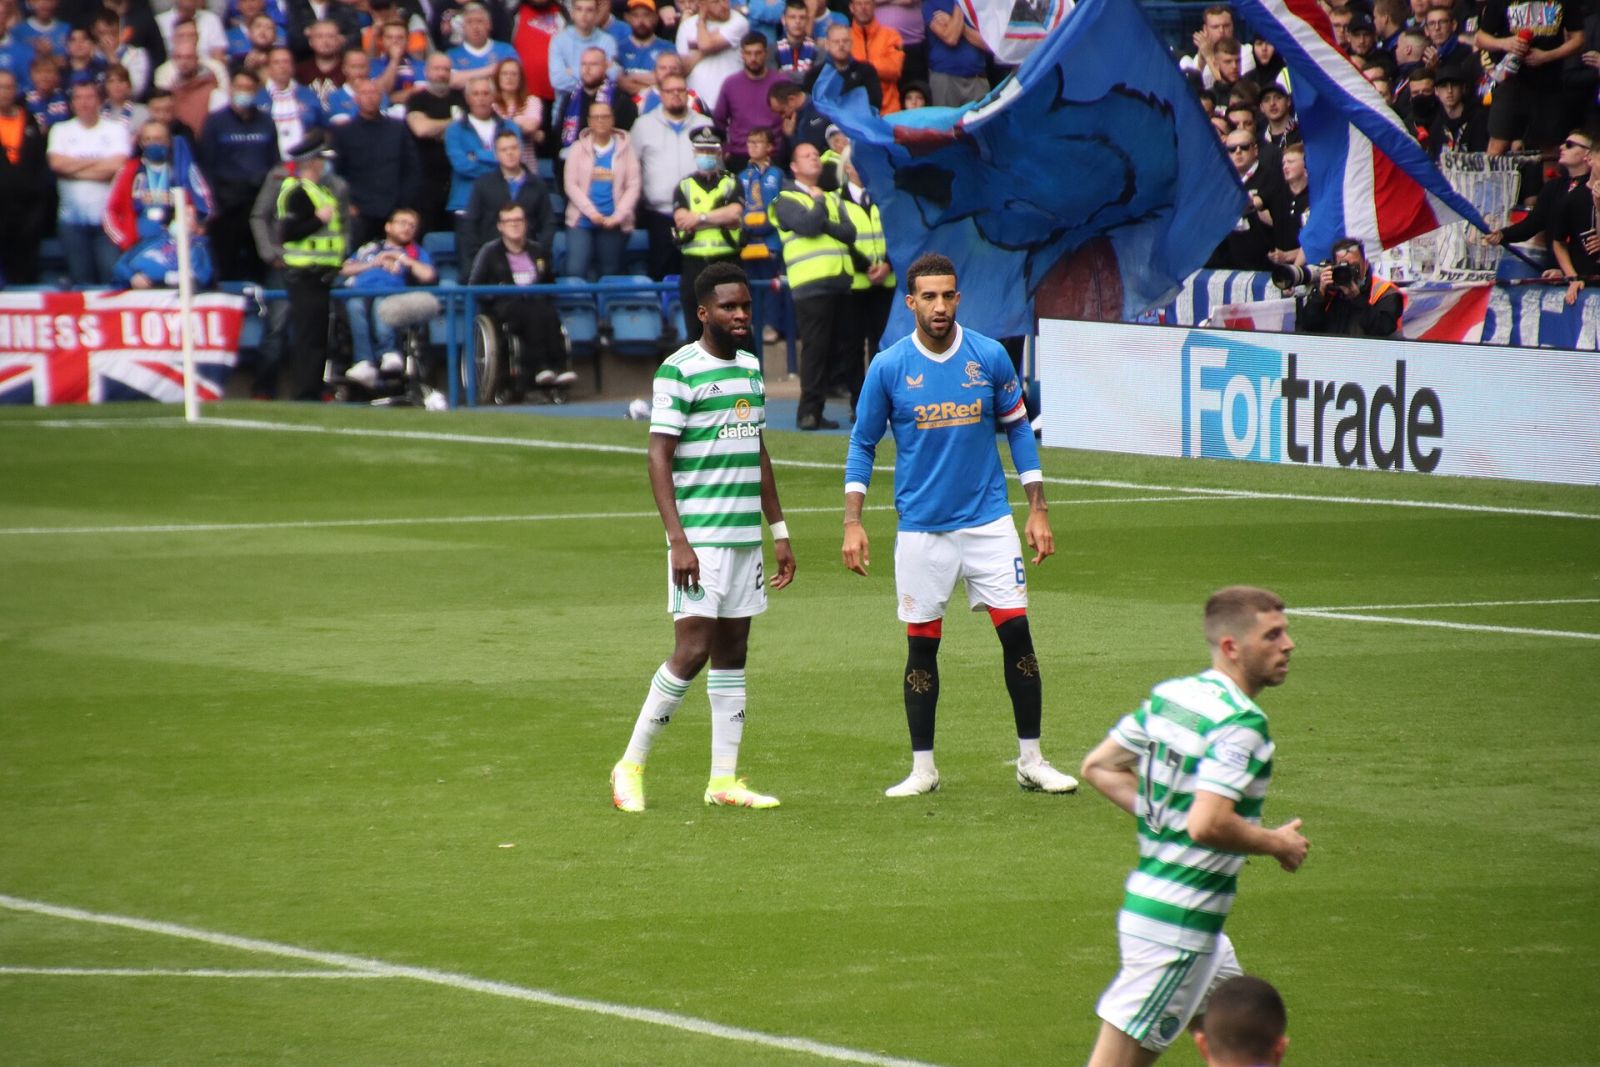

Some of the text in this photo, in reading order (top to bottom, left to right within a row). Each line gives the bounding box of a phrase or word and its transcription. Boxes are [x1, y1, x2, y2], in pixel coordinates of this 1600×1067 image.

[913, 398, 982, 422] 32Red
[1190, 346, 1443, 473] Fortrade
[1014, 556, 1026, 585] 6
